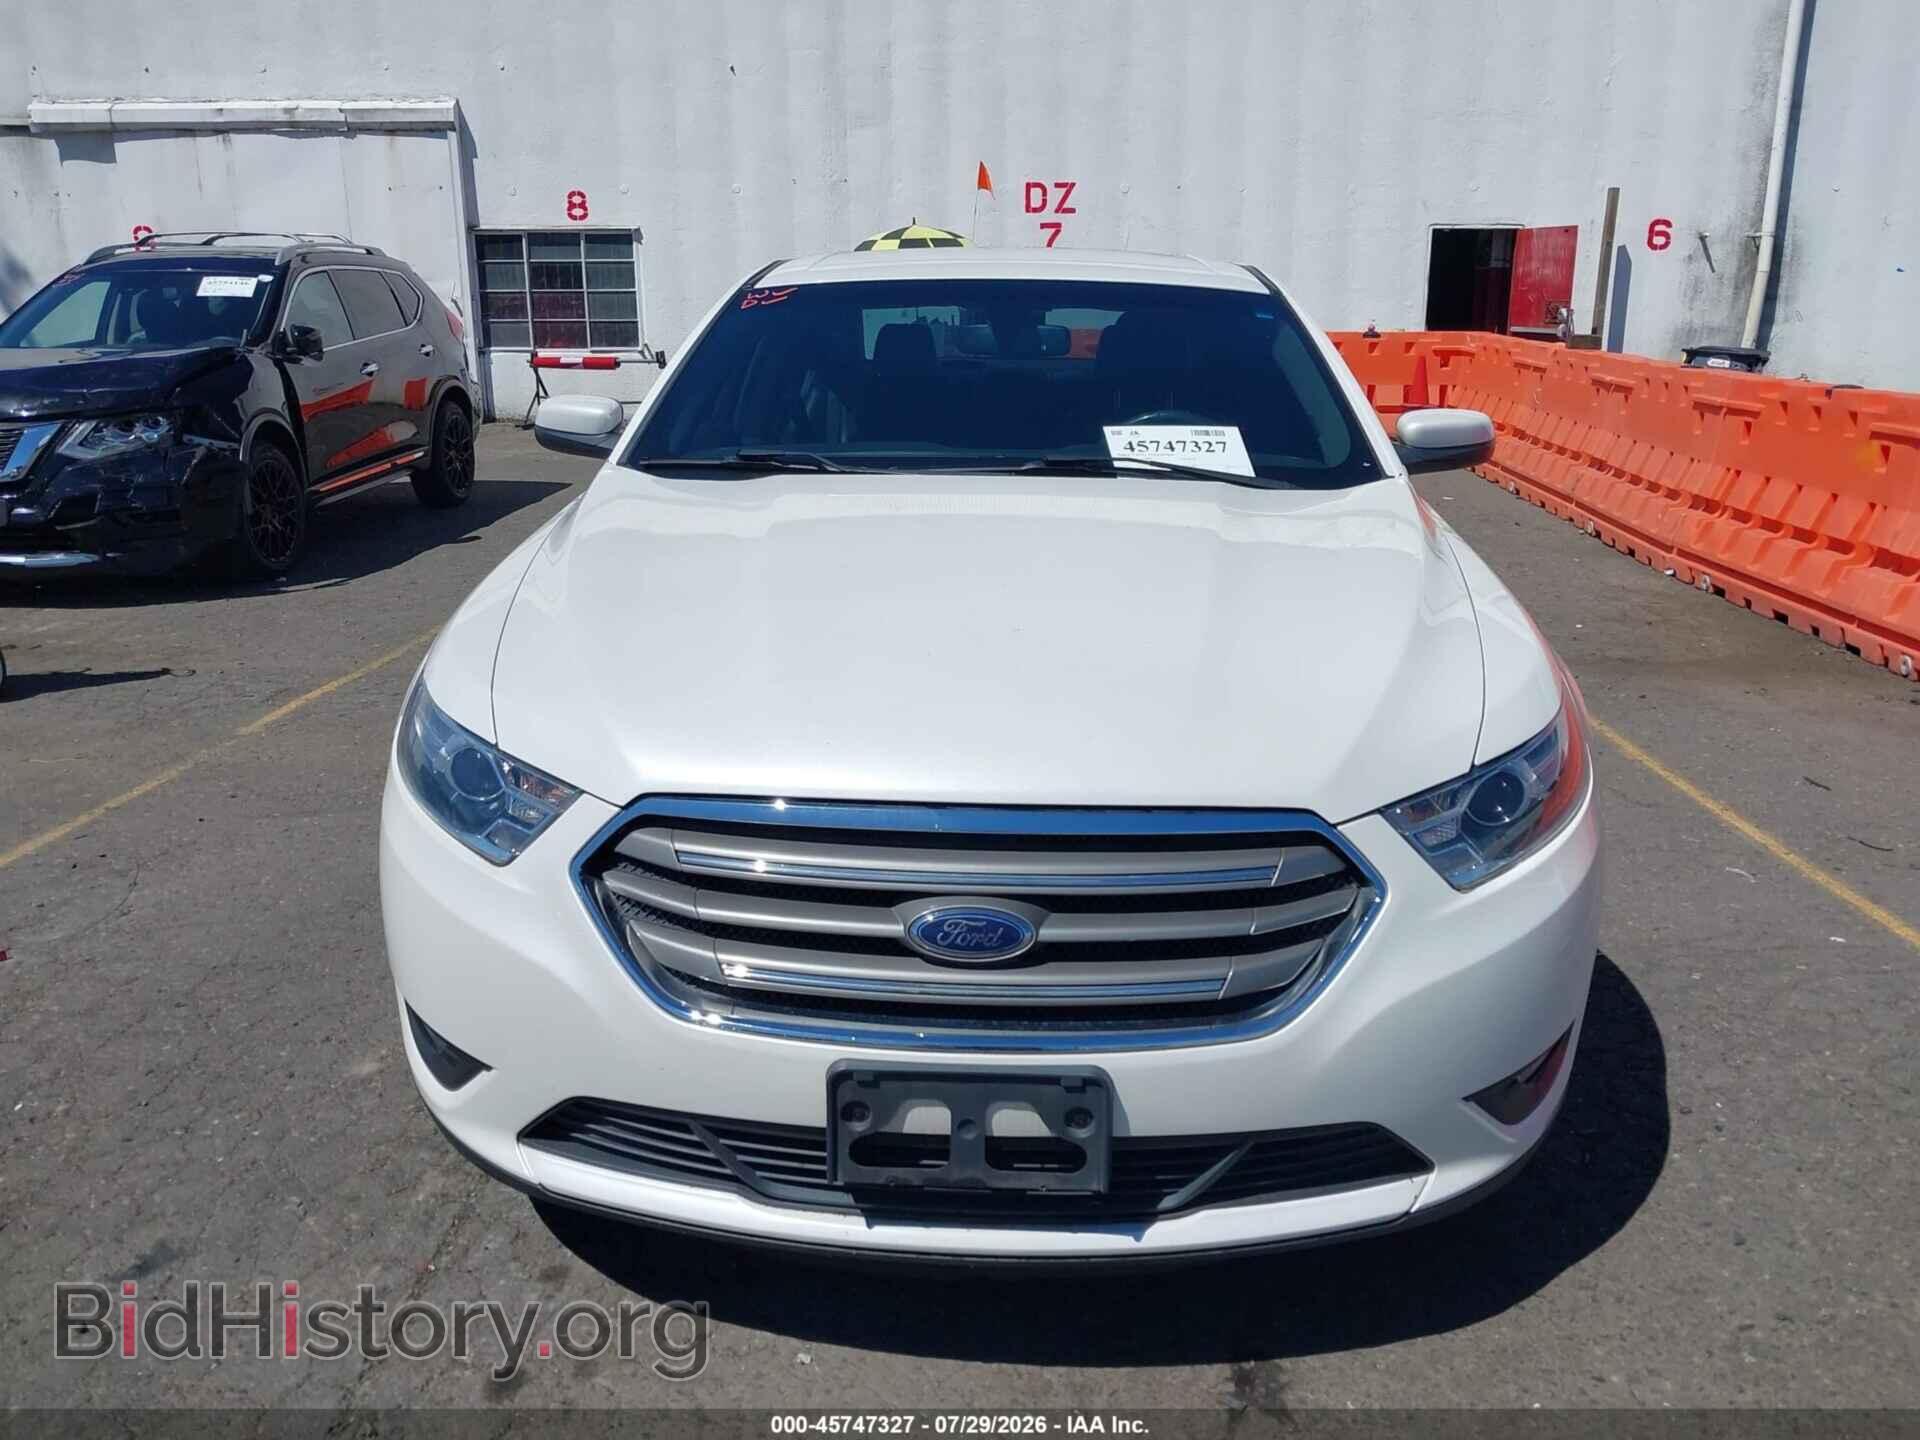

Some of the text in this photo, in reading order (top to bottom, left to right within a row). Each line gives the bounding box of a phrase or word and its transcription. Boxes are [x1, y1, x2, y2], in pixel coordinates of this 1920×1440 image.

[567, 190, 589, 221] 8
[1025, 181, 1077, 214] DZ
[1039, 222, 1062, 248] 7
[1647, 218, 1673, 251] 6
[1123, 440, 1227, 453] 45747327
[937, 919, 1004, 947] Ford
